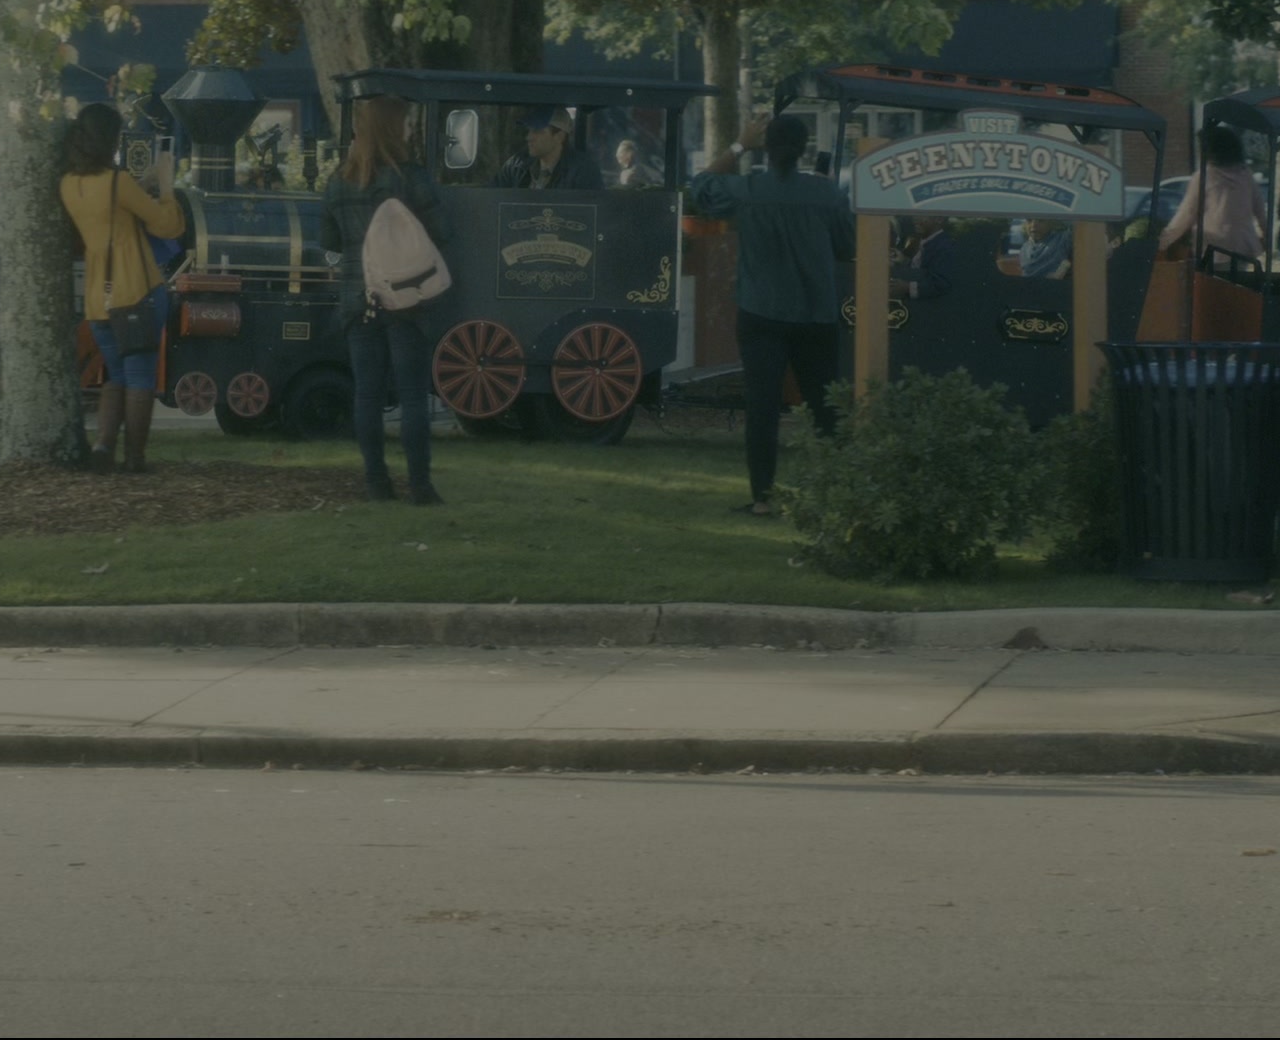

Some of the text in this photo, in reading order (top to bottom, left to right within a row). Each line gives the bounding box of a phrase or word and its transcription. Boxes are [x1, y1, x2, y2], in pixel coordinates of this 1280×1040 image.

[967, 117, 1016, 134] VISIT
[871, 139, 1110, 196] TEENYTOWN
[980, 177, 1009, 189] SMALL
